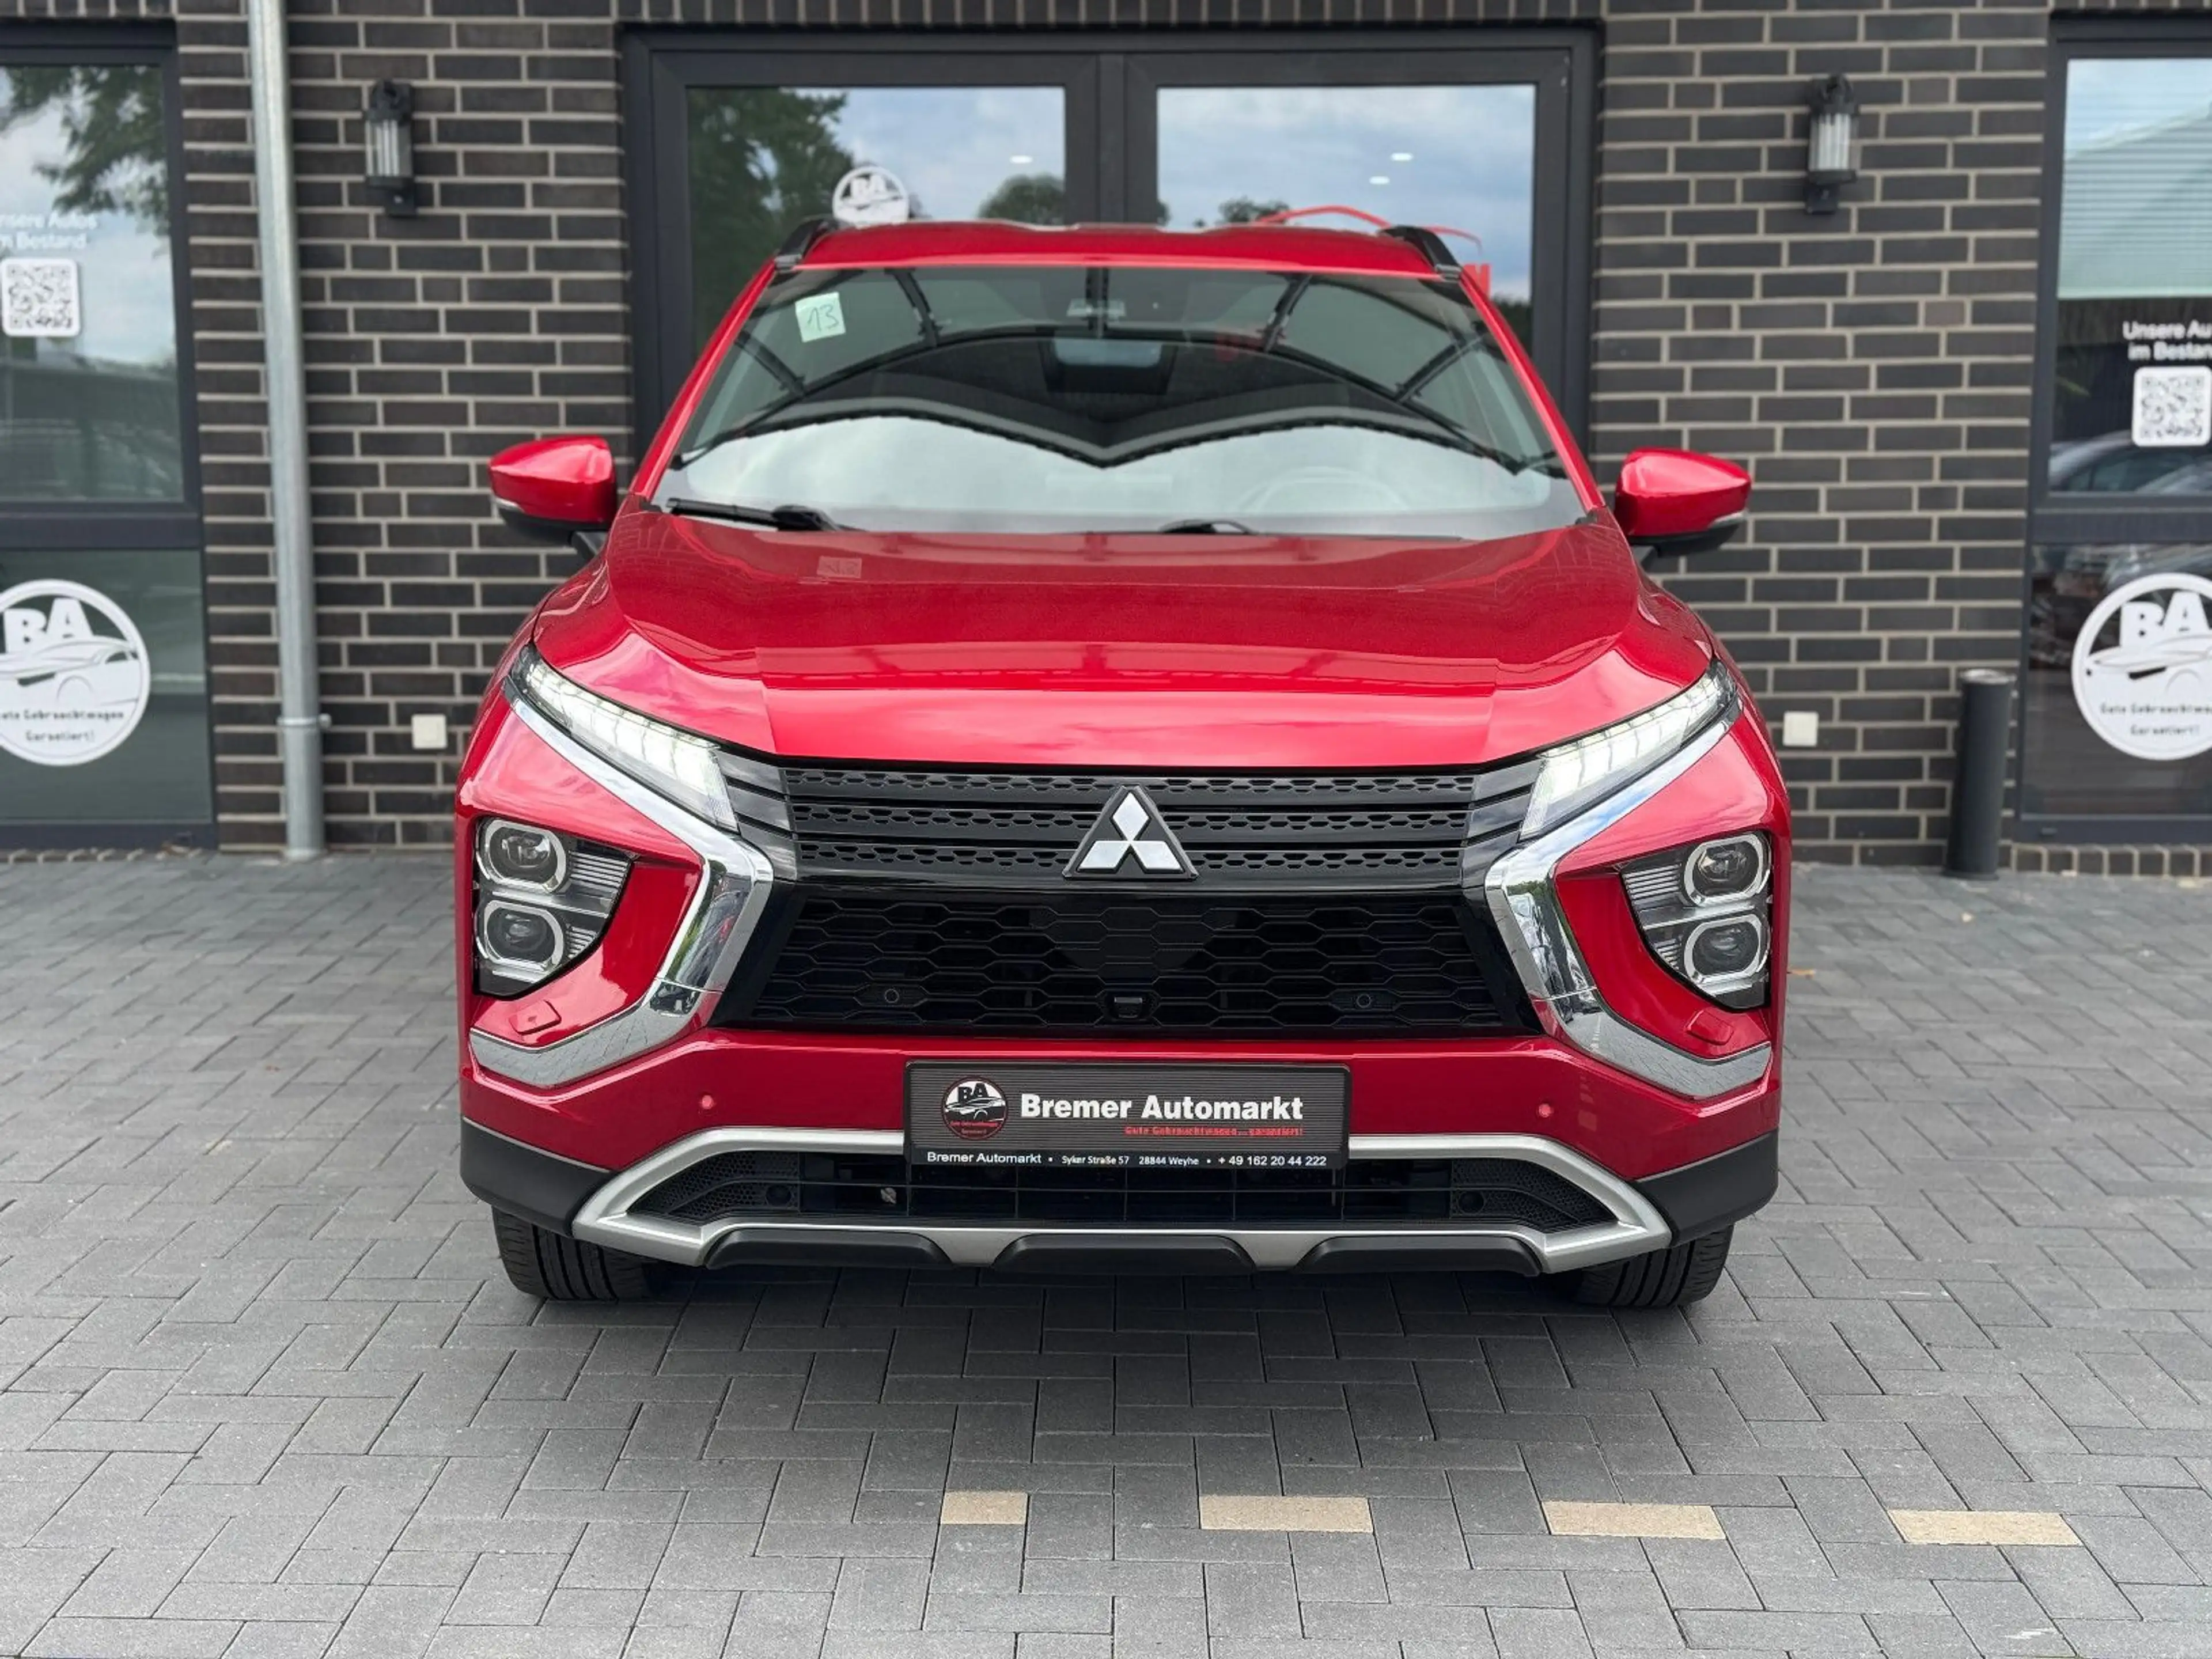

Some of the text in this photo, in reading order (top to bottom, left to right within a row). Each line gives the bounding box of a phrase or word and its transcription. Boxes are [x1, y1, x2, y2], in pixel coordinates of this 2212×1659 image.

[3, 597, 94, 654] BA
[2119, 591, 2211, 647] BA
[957, 1082, 990, 1103] BA
[1021, 1094, 1303, 1119] Bremer Automarkt
[1125, 1127, 1149, 1137] Gute
[927, 1152, 974, 1163] Bremer
[976, 1153, 1042, 1164] Automarkt
[1061, 1155, 1086, 1165] Syker
[1088, 1156, 1116, 1165] Straße
[1118, 1156, 1130, 1165] 57
[1139, 1156, 1166, 1165] 28844
[1169, 1156, 1200, 1166] Weyhe
[1228, 1156, 1244, 1165] 49
[1247, 1156, 1268, 1166] 162
[1270, 1156, 1285, 1166] 20
[1287, 1156, 1302, 1166] 44
[1305, 1156, 1327, 1166] 222
